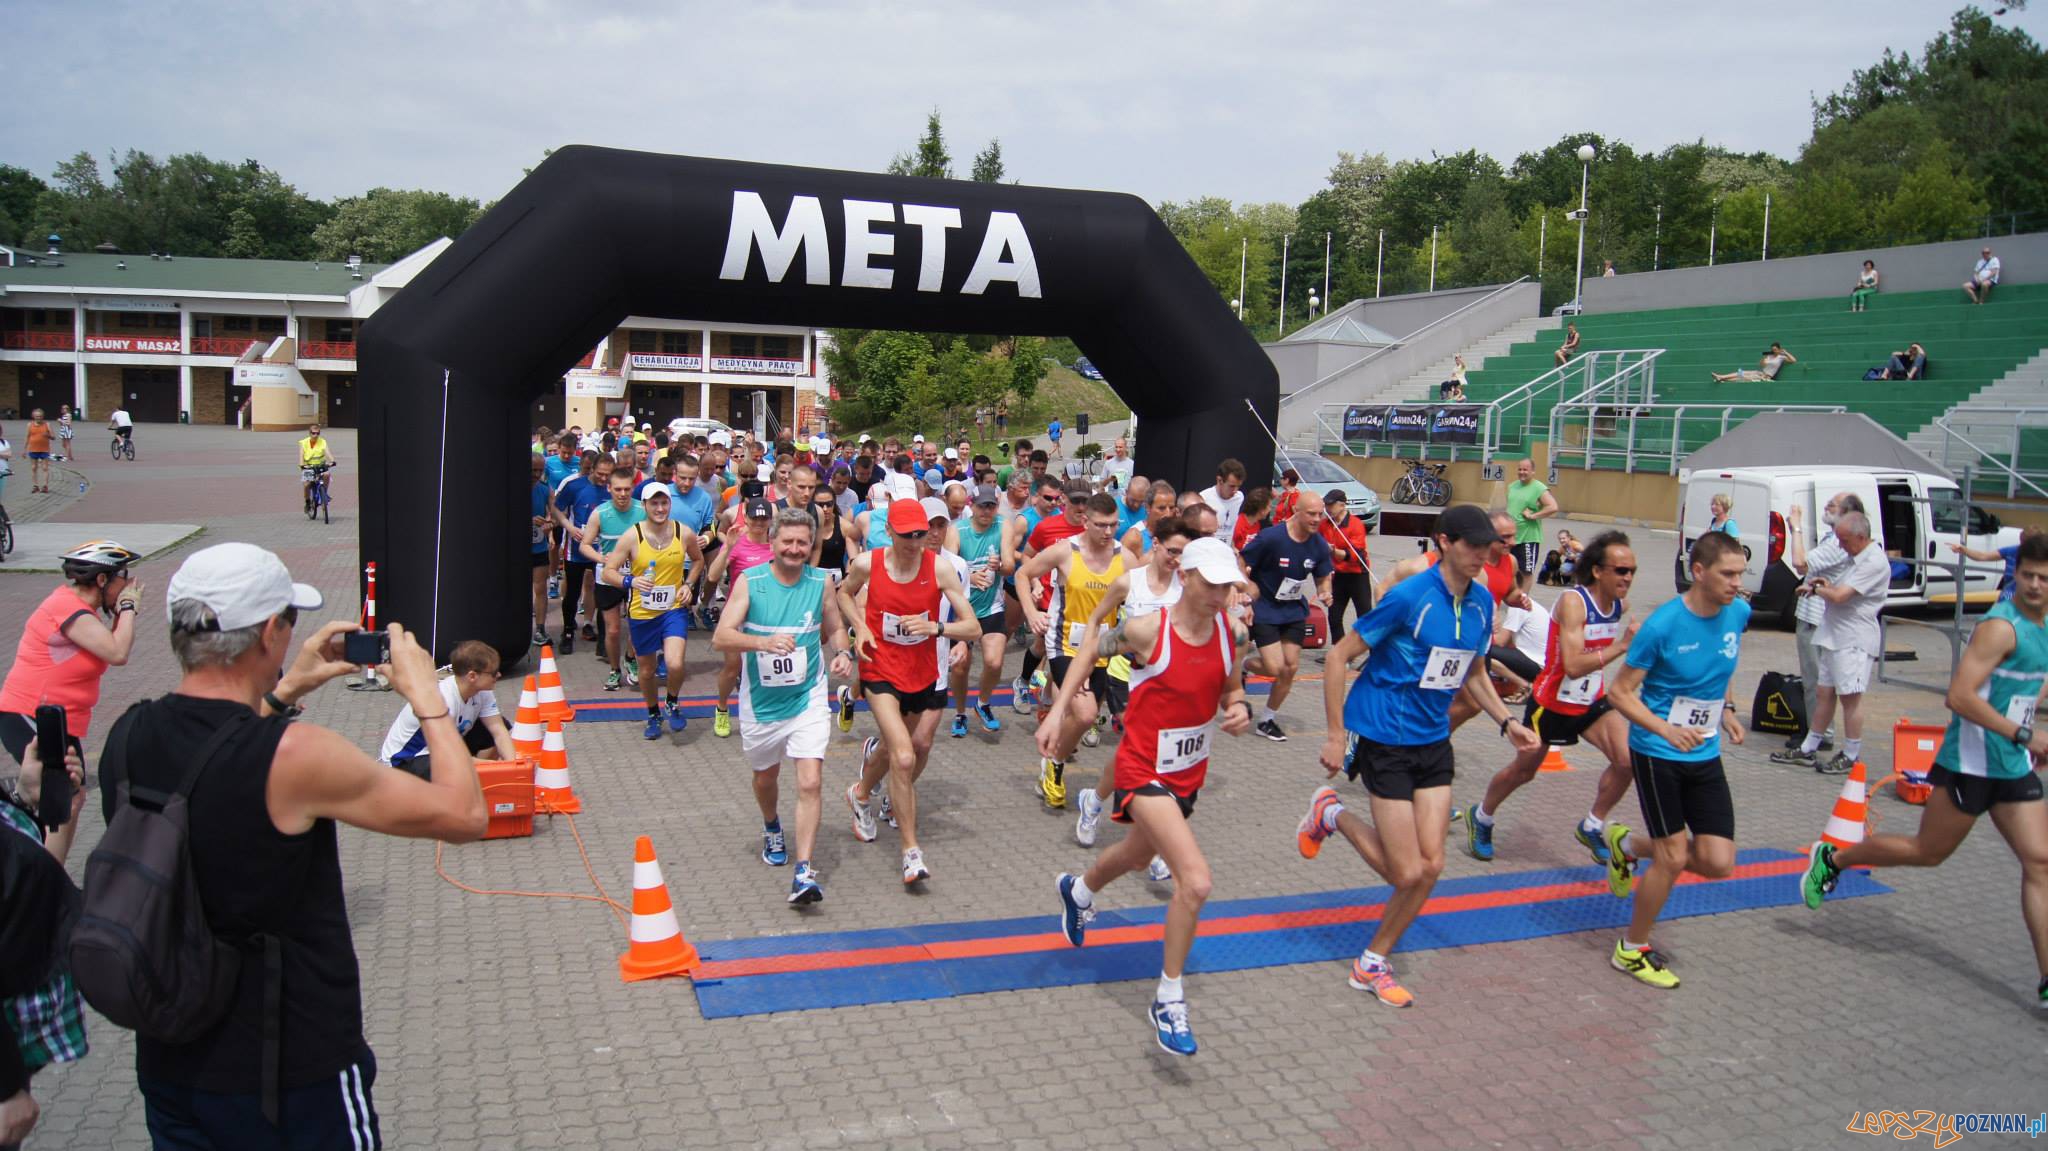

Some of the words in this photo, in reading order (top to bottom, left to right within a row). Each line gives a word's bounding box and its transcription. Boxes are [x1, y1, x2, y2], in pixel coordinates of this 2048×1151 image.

[719, 190, 1042, 298] META
[86, 339, 130, 350] SAUNY
[136, 341, 180, 351] MASAŻ
[634, 355, 699, 366] REHABILITACJA
[717, 359, 763, 369] MEDYCYNA
[769, 361, 796, 370] PRACY
[651, 592, 669, 603] 187
[773, 658, 793, 674] 90
[1441, 659, 1460, 677] 88
[1580, 679, 1590, 693] 4
[1688, 708, 1711, 726] 55
[1175, 733, 1205, 757] 108
